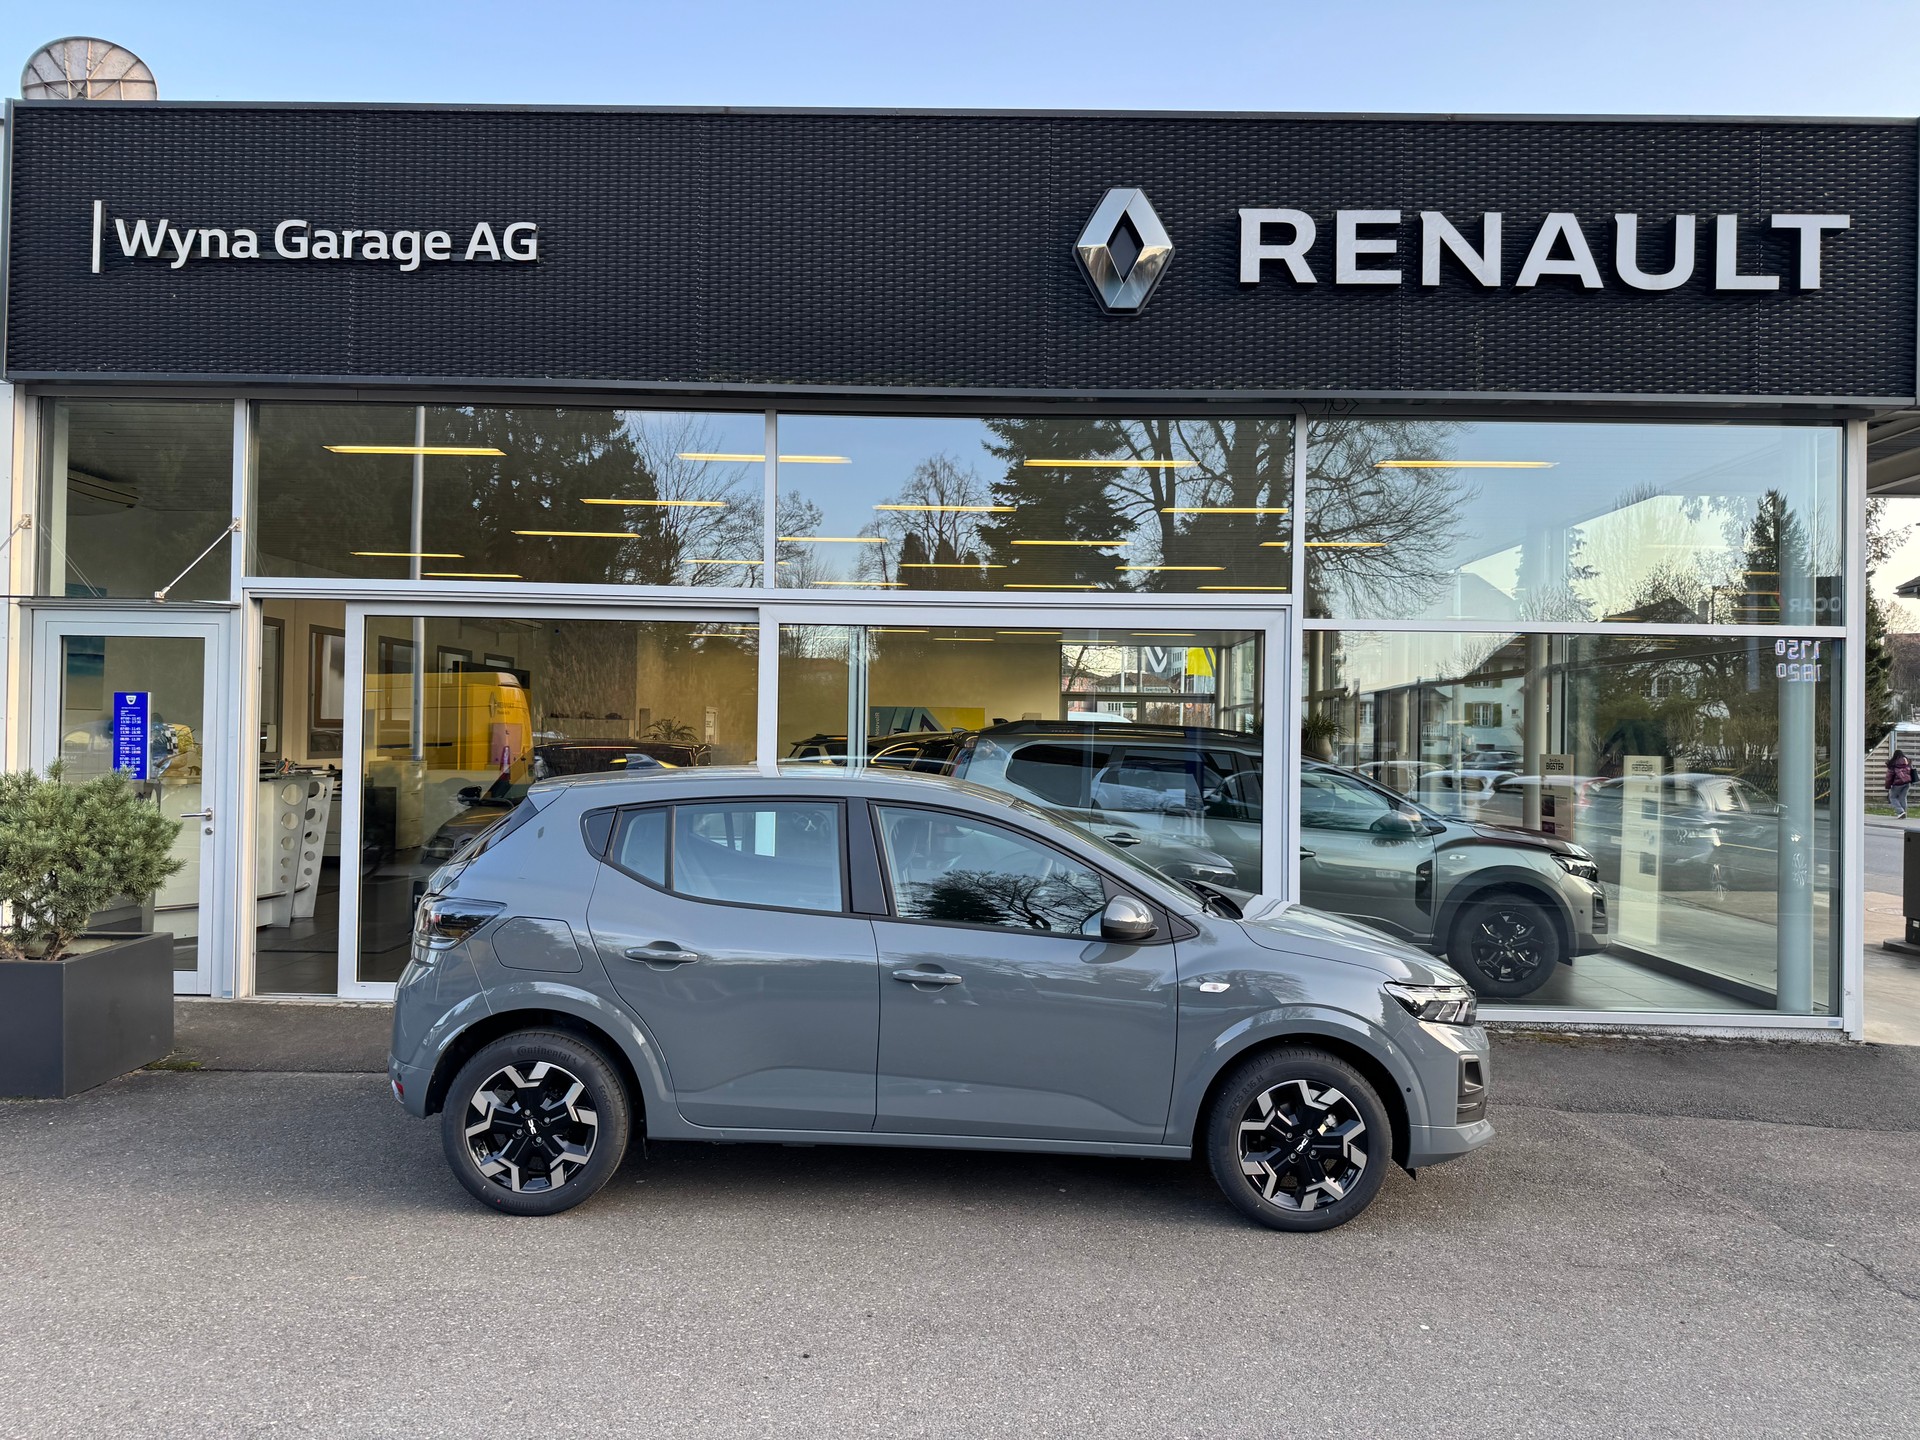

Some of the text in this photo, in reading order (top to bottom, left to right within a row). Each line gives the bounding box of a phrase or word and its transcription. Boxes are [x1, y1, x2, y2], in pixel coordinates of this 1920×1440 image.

[115, 219, 537, 271] Wyna Garage AG
[1239, 208, 1850, 290] RENAULT
[1546, 762, 1564, 770] BIGSTER
[517, 1045, 571, 1062] Continental
